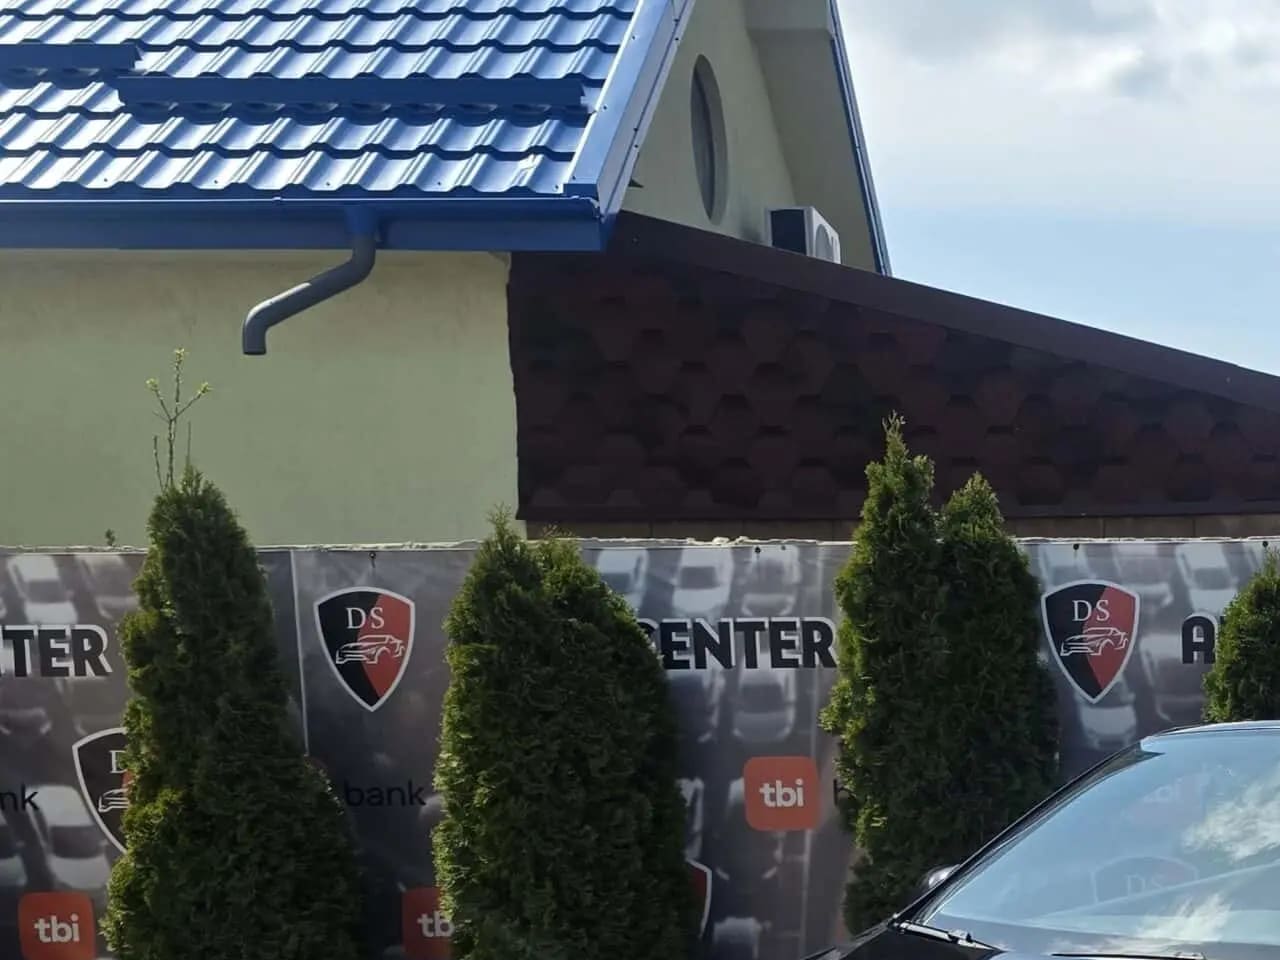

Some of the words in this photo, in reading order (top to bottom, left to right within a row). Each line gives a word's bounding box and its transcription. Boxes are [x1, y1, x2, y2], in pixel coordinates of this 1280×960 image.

[346, 606, 385, 630] DS
[1072, 599, 1110, 623] DS
[343, 780, 426, 808] bank
[759, 778, 805, 808] tbi
[33, 913, 81, 943] tbi
[417, 910, 455, 938] tb
